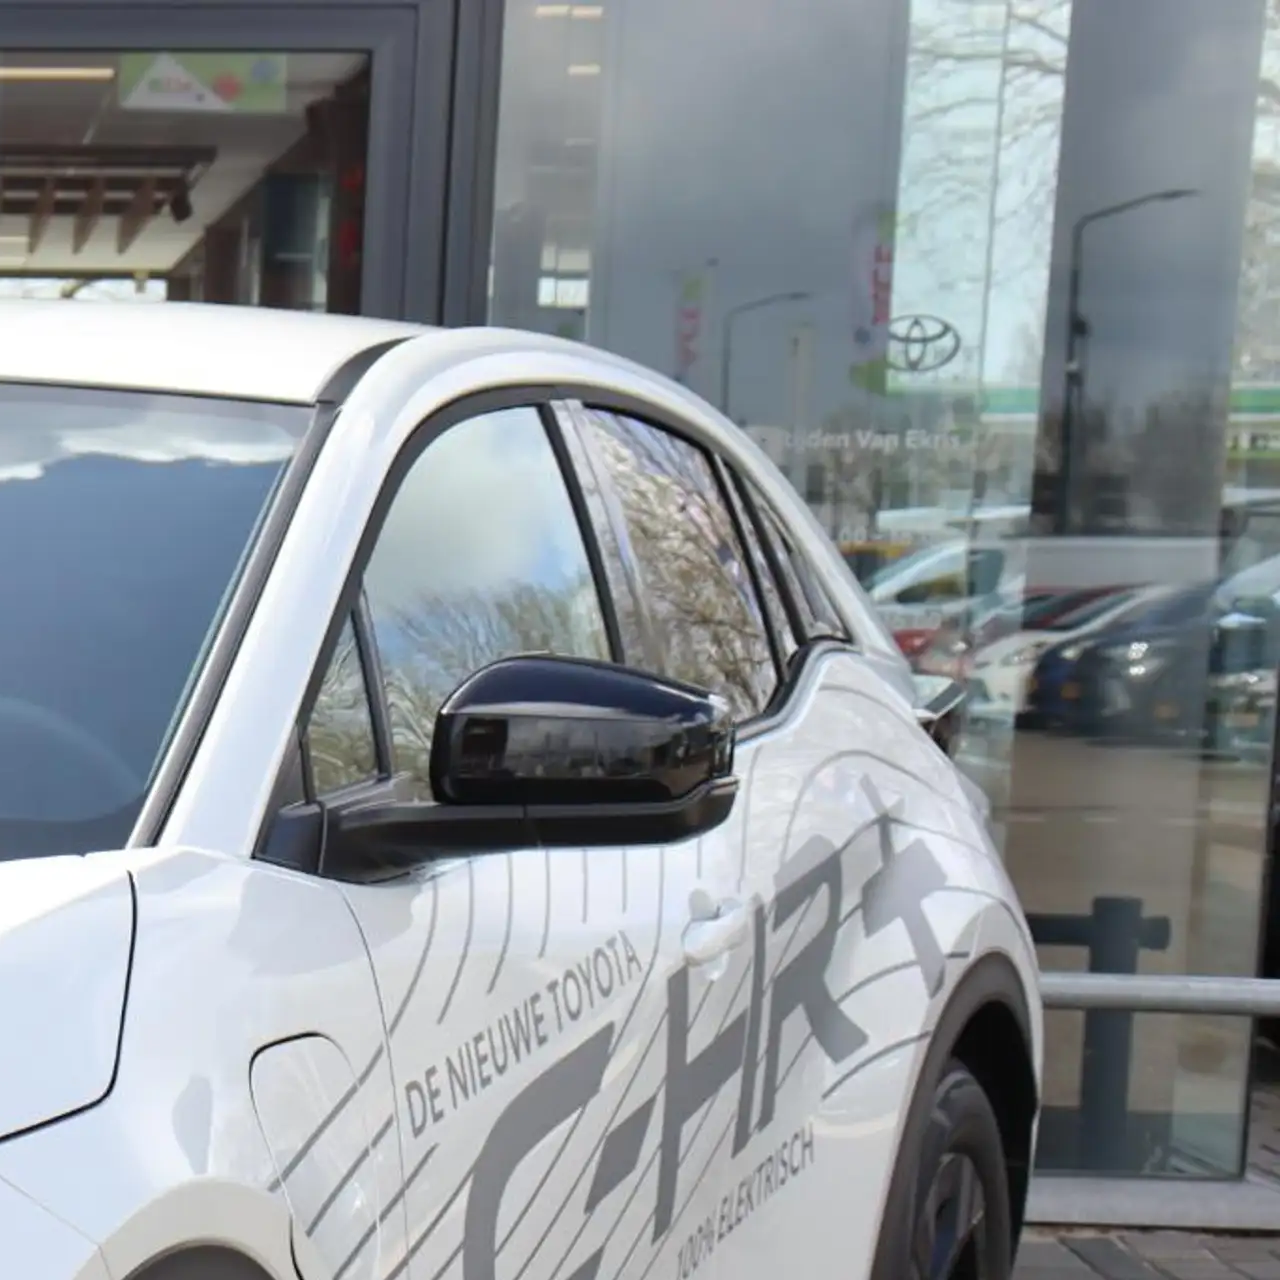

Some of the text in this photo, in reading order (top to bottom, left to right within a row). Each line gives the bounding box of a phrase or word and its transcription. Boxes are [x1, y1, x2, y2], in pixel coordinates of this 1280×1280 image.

[404, 929, 642, 1139] DE NIEUWE TOYOTA
[717, 1121, 815, 1244] ELEKTRISCH
